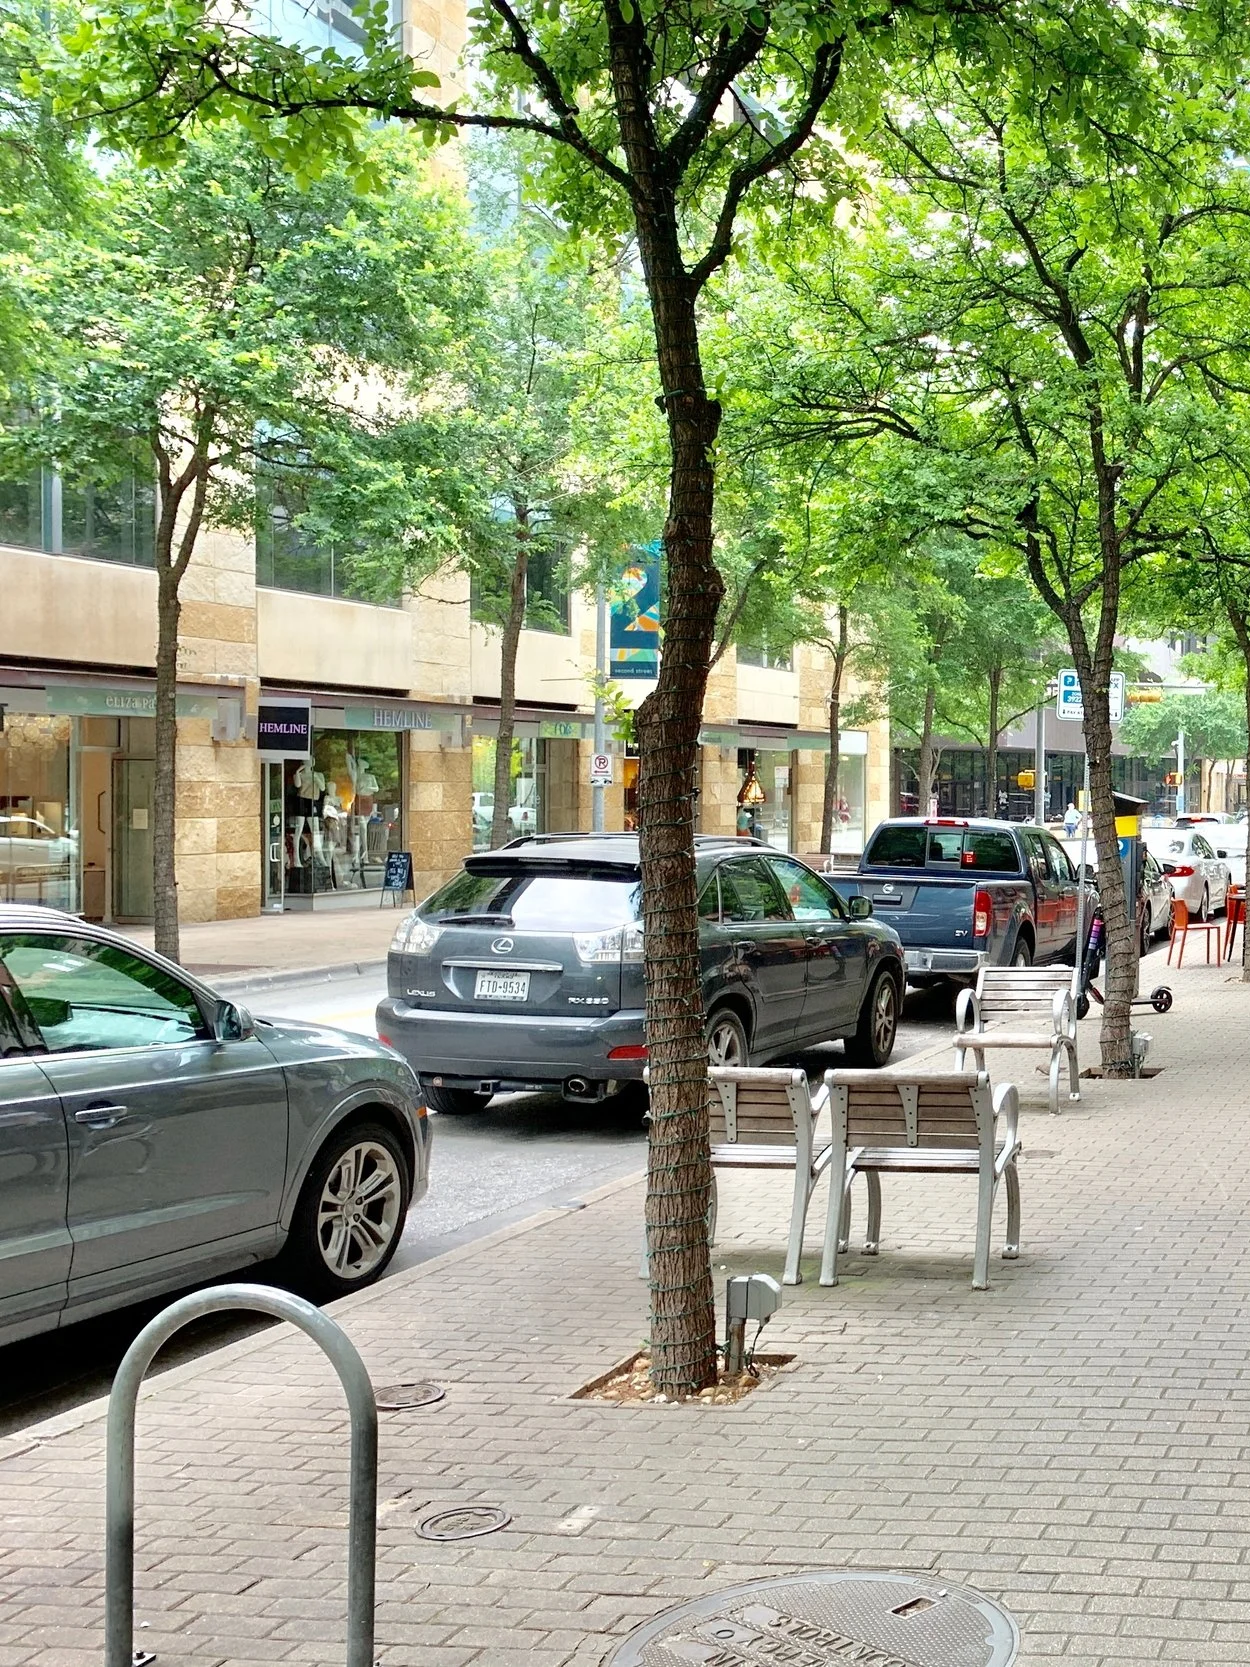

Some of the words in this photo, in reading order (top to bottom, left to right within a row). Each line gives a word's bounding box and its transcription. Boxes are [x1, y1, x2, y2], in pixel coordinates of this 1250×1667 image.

[373, 709, 433, 729] HEMLINE
[259, 722, 308, 735] HEMLINE
[406, 988, 436, 998] LEXUS
